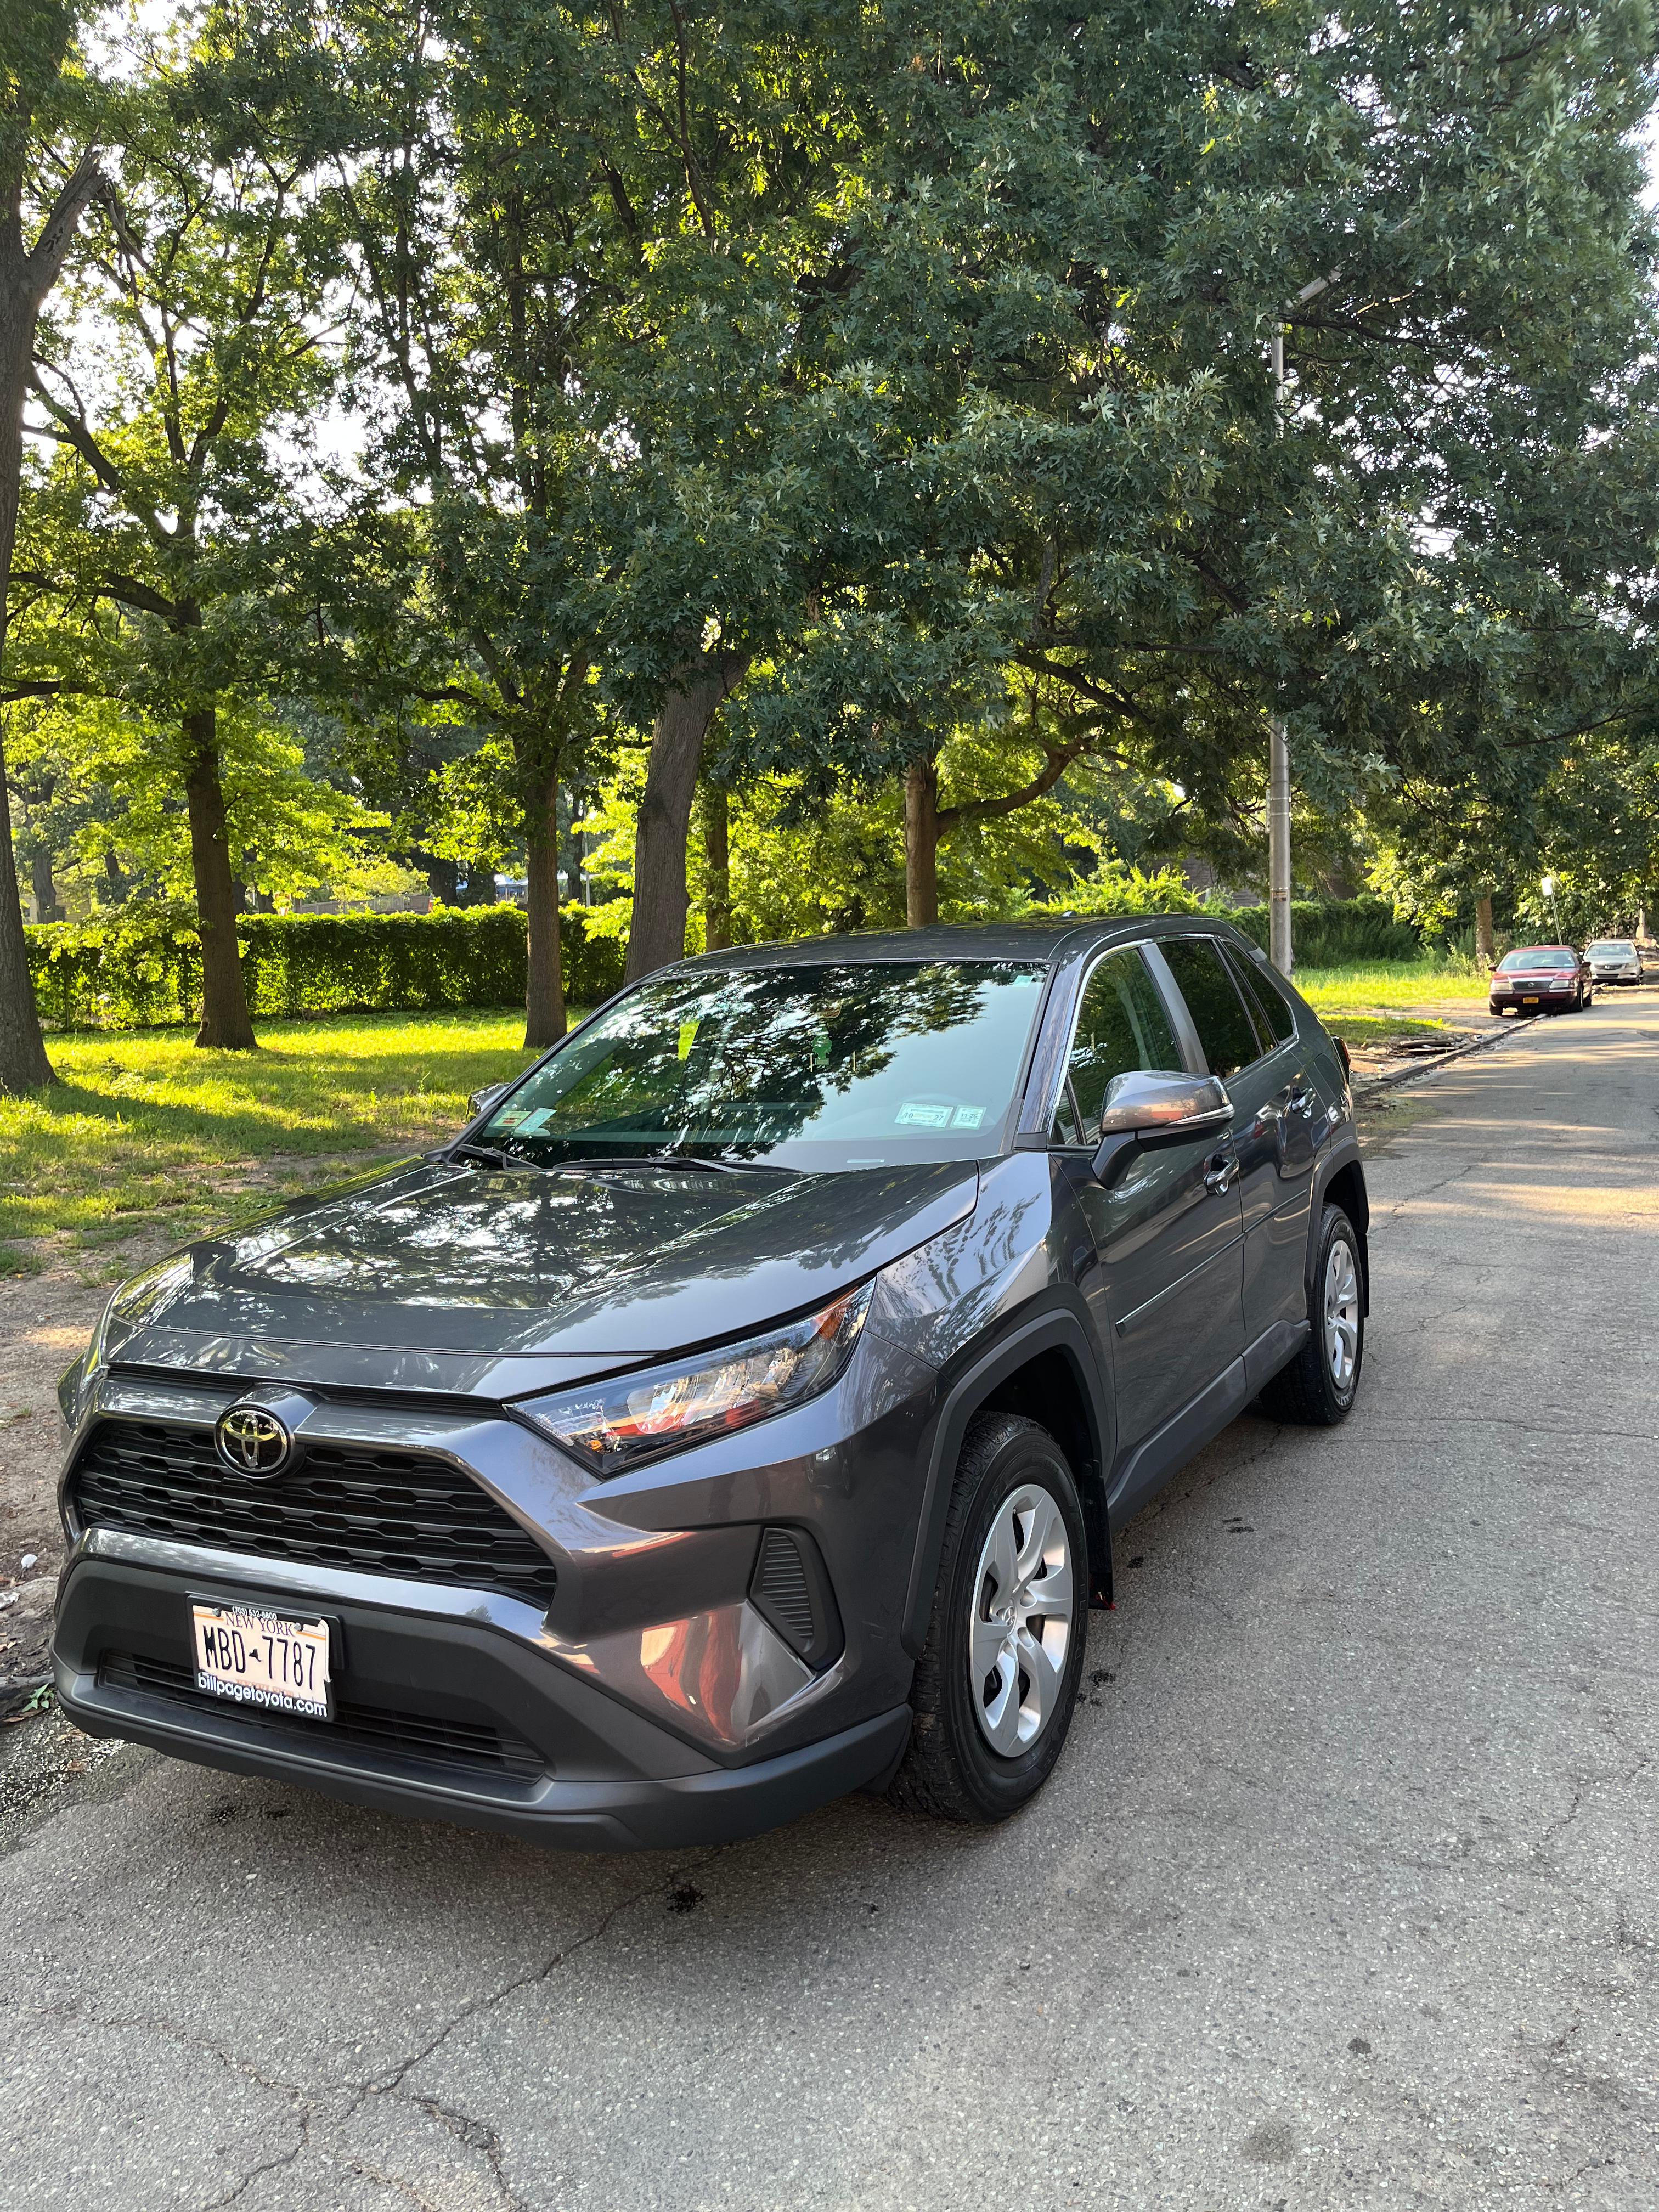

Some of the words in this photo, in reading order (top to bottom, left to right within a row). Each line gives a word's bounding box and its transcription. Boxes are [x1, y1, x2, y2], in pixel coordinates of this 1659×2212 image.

[225, 1612, 255, 1629] NEW
[257, 1617, 296, 1638] YORK
[232, 1606, 248, 1616] (703)
[203, 1624, 246, 1673] MBD
[262, 1635, 315, 1690] 7787
[198, 1672, 328, 1717] billpagetoyota.com
